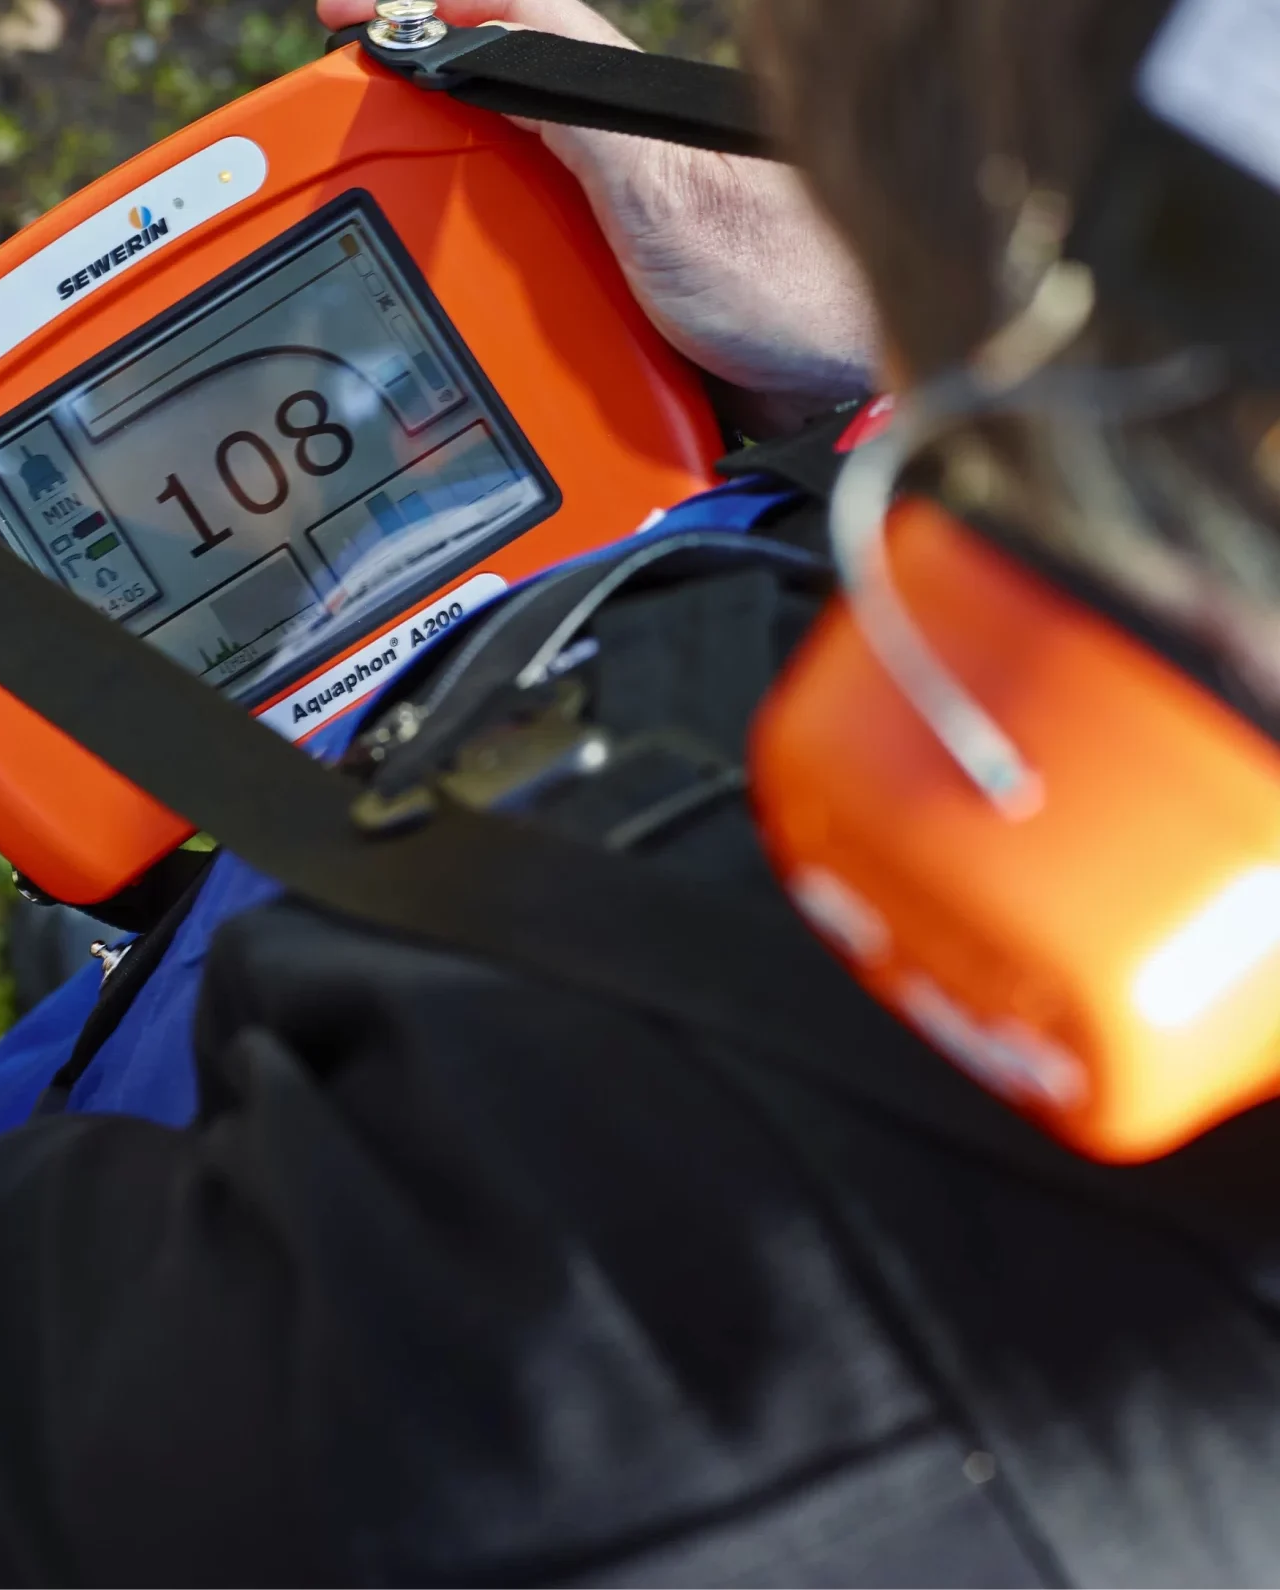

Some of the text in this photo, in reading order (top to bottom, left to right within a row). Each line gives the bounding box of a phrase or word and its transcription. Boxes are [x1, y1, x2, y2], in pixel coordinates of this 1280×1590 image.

[57, 217, 169, 301] SEWERIN
[156, 389, 355, 558] 108
[42, 495, 82, 524] MIN
[409, 602, 463, 649] A200
